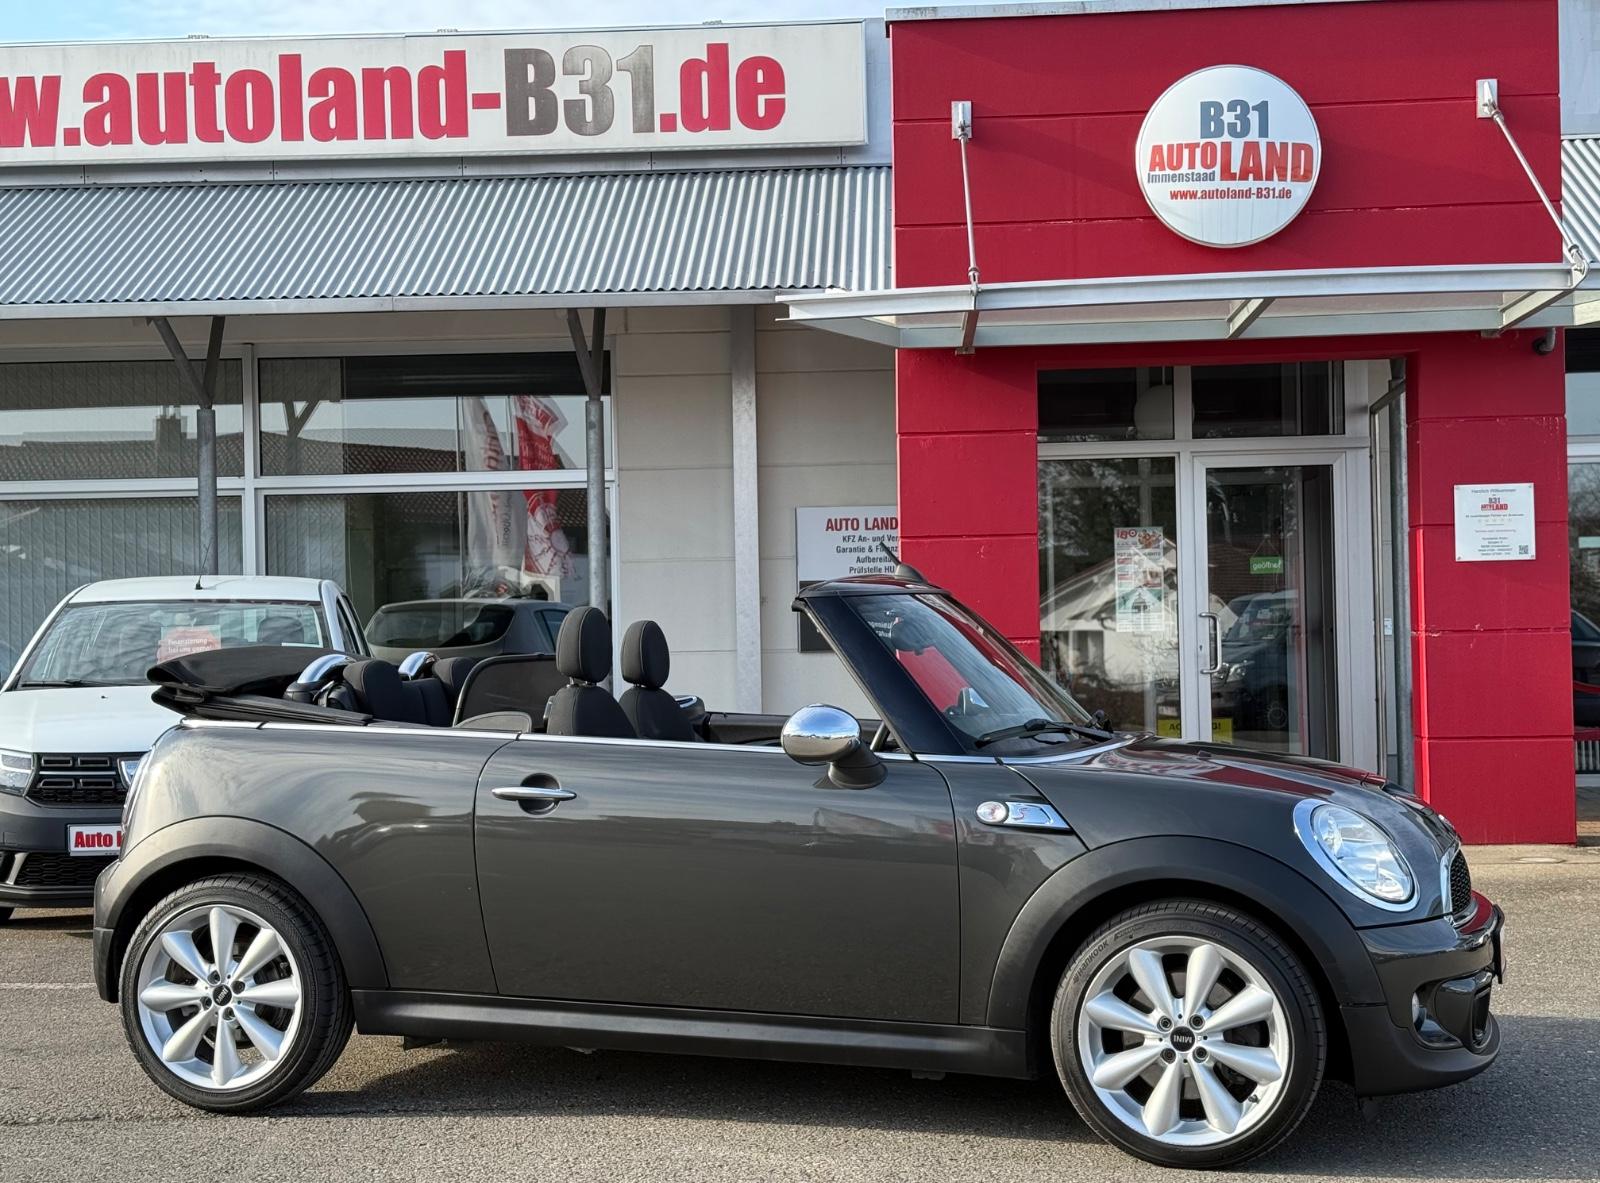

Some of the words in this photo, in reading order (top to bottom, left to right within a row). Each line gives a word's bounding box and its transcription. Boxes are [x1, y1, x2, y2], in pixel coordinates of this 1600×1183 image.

[1200, 99, 1269, 139] B31
[1147, 170, 1216, 184] Immenstaad
[1169, 186, 1292, 201] www.autoland-B31.de
[825, 517, 860, 532] AUTO
[864, 516, 899, 531] LAND
[842, 535, 856, 543] KFZ
[872, 534, 885, 542] und
[836, 545, 866, 553] Garantie
[868, 545, 873, 553] &
[849, 566, 883, 574] Prüfstelle
[74, 831, 113, 848] Auto
[1173, 1034, 1193, 1044] MINI
